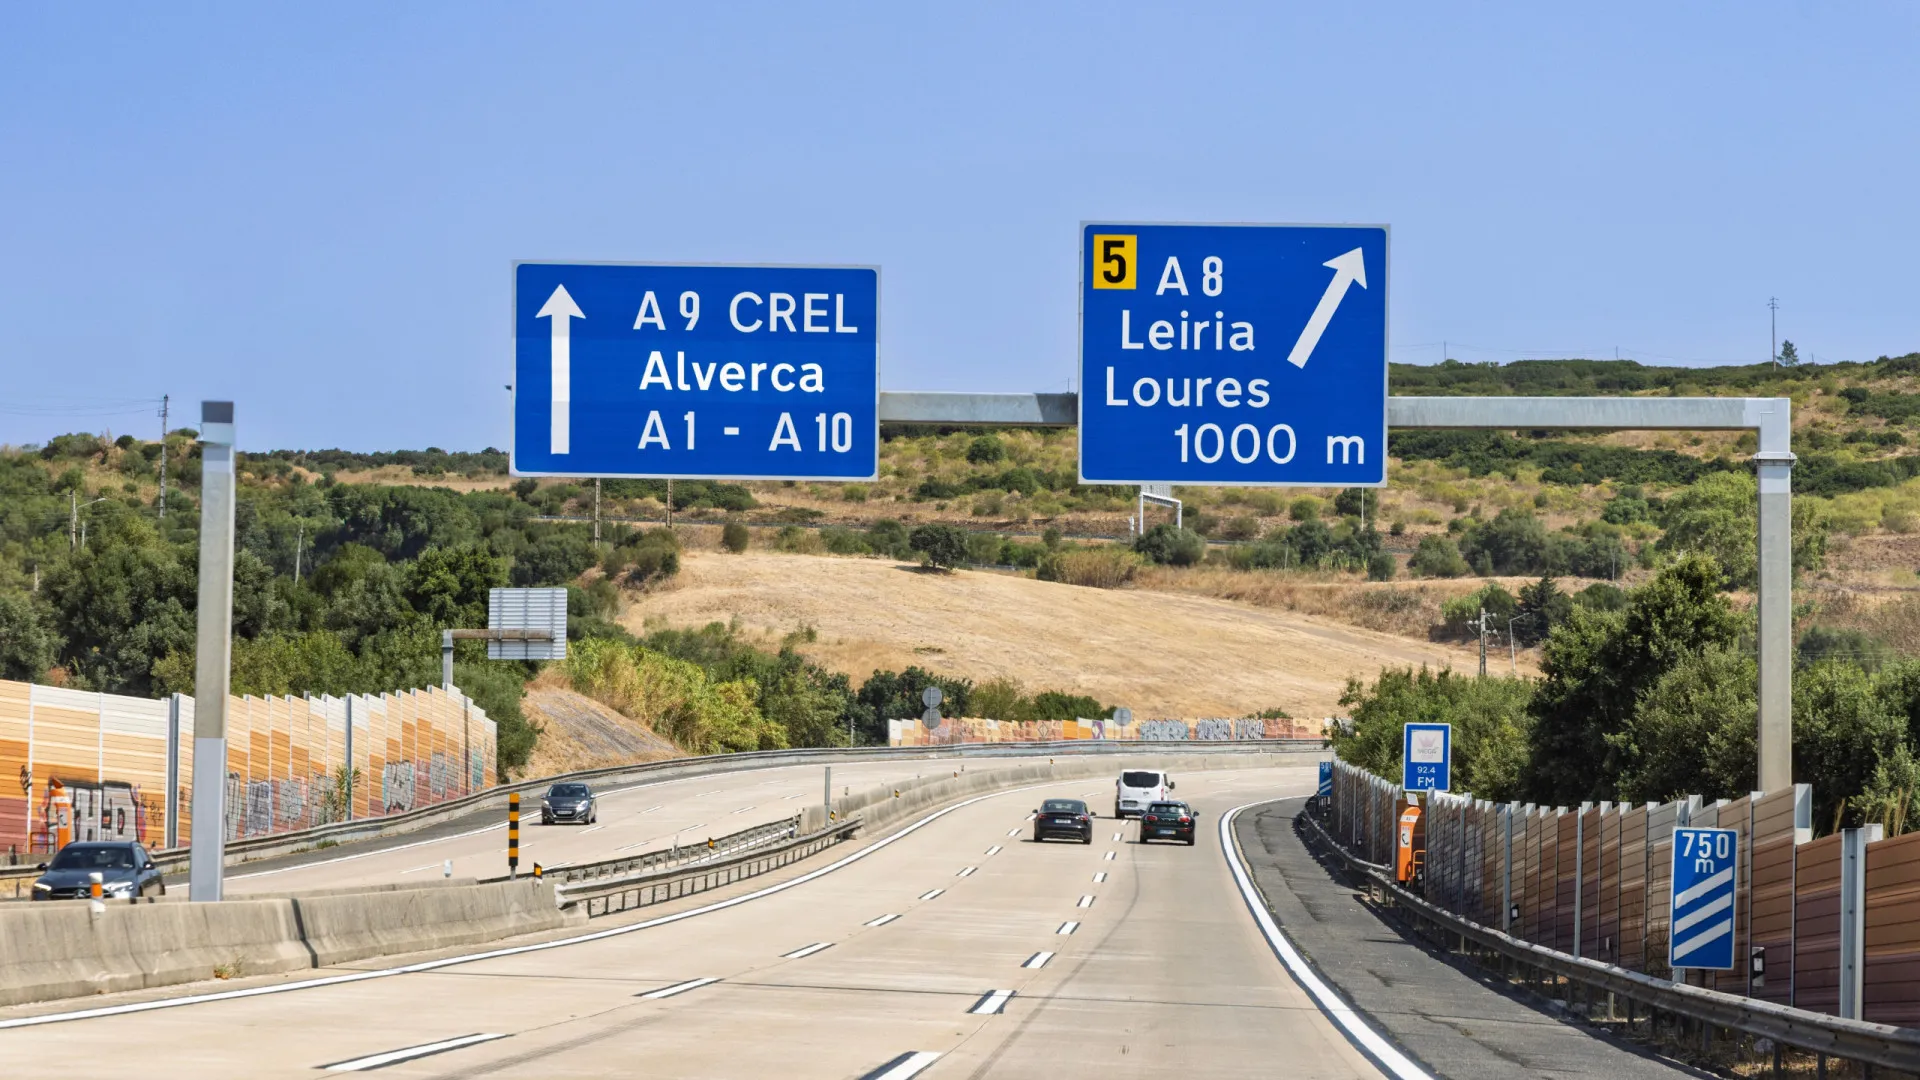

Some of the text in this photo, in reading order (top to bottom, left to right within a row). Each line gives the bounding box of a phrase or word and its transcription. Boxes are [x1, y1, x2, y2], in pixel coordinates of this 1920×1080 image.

[1103, 240, 1127, 284] 5
[729, 291, 858, 333] CREL
[1121, 309, 1255, 352] Leiria
[639, 350, 825, 393] Alverca
[1106, 366, 1270, 409] Loures
[1174, 422, 1365, 465] 1000 m
[1417, 766, 1436, 774] 92.4
[1417, 776, 1435, 787] FM
[1682, 832, 1729, 859] 750
[1695, 858, 1714, 874] m
